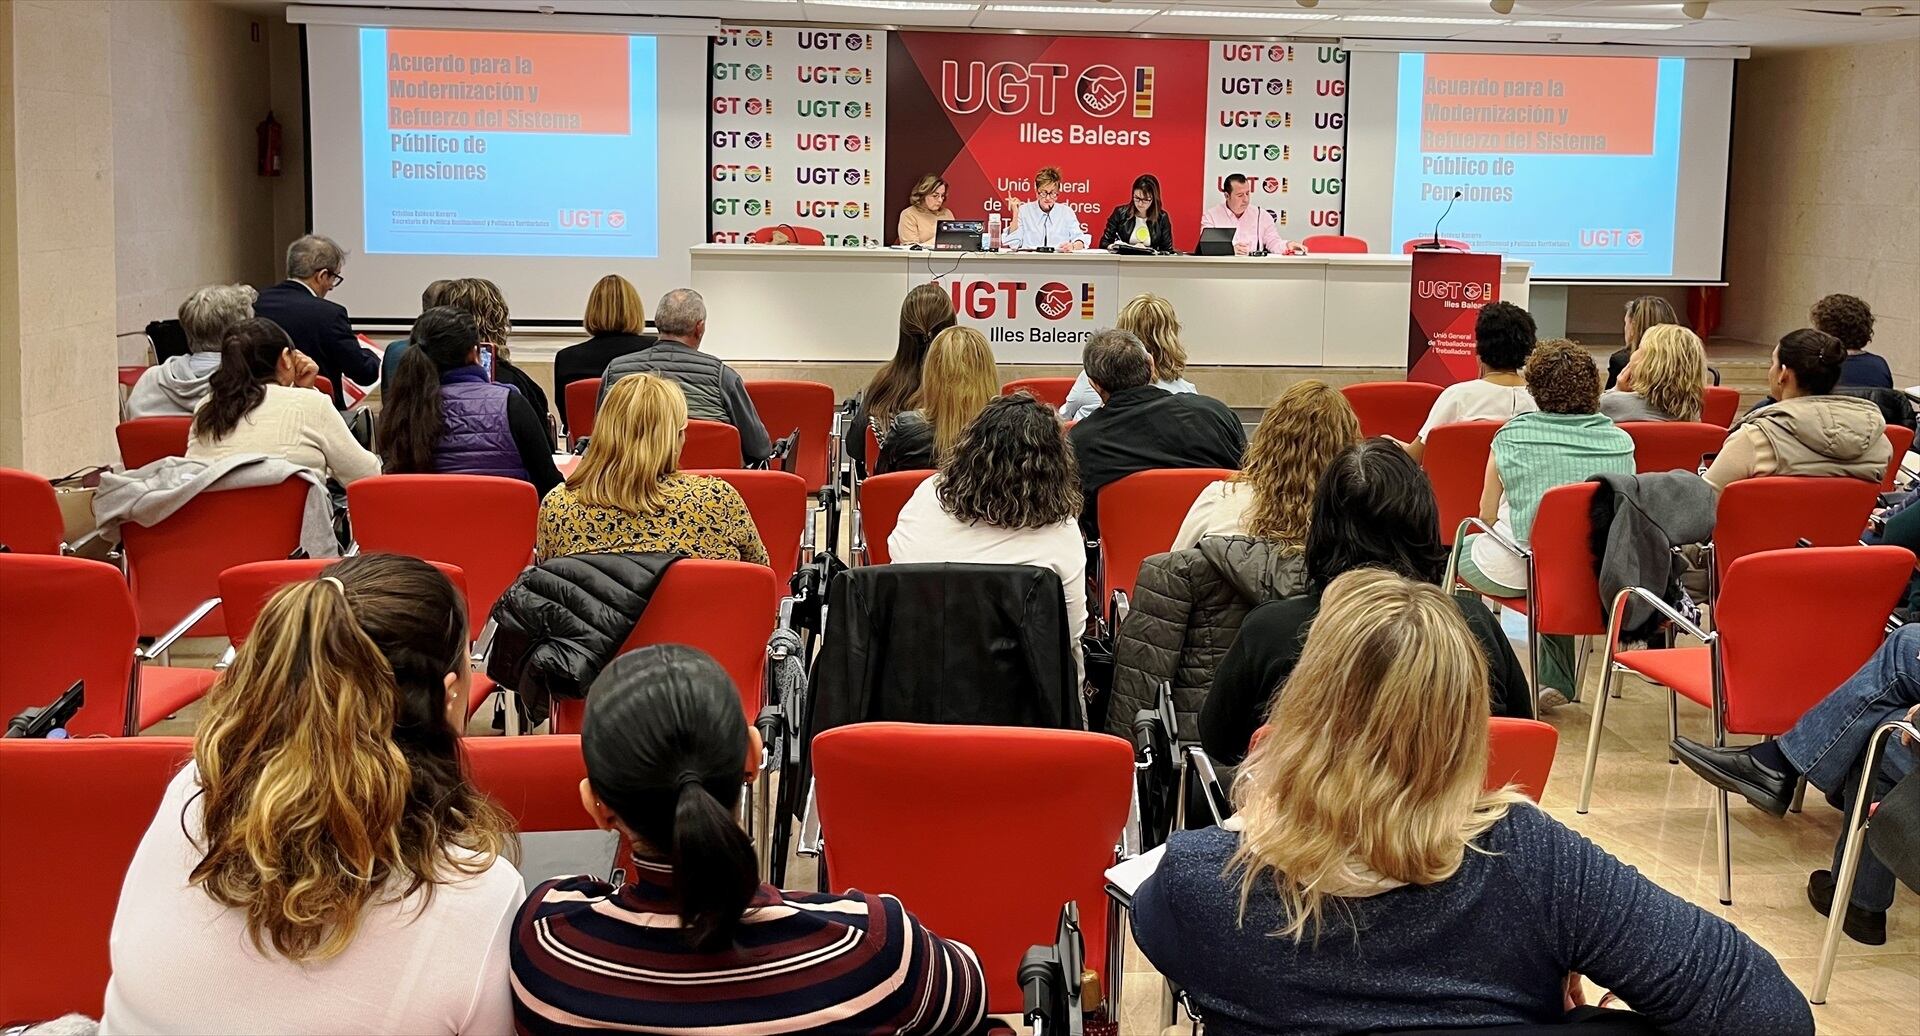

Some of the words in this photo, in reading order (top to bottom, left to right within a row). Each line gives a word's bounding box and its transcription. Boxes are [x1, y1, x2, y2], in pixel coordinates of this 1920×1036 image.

[714, 29, 741, 46] GT
[798, 32, 841, 50] UGT
[1223, 44, 1264, 61] UGT
[1317, 47, 1345, 64] UG
[388, 53, 465, 72] Acuerdo
[470, 56, 510, 75] para
[515, 55, 532, 74] la
[713, 63, 741, 80] GT
[798, 66, 841, 84] UGT
[389, 80, 524, 101] Modernización
[529, 85, 538, 102] y
[942, 60, 1068, 115] UGT
[1222, 77, 1263, 95] UGT
[1316, 79, 1345, 96] UG
[1425, 76, 1499, 96] Acuerdo
[1503, 79, 1543, 98] para
[1547, 78, 1564, 97] la
[713, 97, 741, 114] GT
[797, 100, 840, 117] UGT
[1424, 103, 1554, 123] Modernización
[1558, 107, 1569, 125] y
[389, 107, 470, 127] Refuerzo
[475, 109, 502, 128] del
[507, 109, 580, 129] Sistema
[1220, 111, 1262, 128] UGT
[1315, 113, 1345, 129] UG
[391, 133, 459, 153] Público
[464, 134, 486, 153] de
[713, 130, 741, 148] GT
[797, 134, 840, 151] UGT
[1020, 123, 1063, 144] Illes
[1069, 125, 1151, 146] Balears
[1423, 130, 1500, 149] Refuerzo
[1504, 131, 1532, 150] del
[1536, 131, 1606, 151] Sistema
[1219, 143, 1260, 160] UGT
[1313, 145, 1344, 162] UG
[391, 160, 487, 180] Pensiones
[713, 164, 740, 181] GT
[1422, 155, 1489, 175] Público
[1493, 156, 1514, 175] de
[797, 167, 839, 185] UGT
[998, 178, 1030, 191] Unió
[1218, 176, 1259, 193] UT
[1312, 178, 1343, 194] UG
[1421, 183, 1513, 202] Pensiones
[713, 198, 740, 215] GT
[796, 201, 839, 218] UGT
[984, 198, 1001, 211] de
[559, 210, 603, 228] UGT
[1310, 210, 1342, 227] UG
[713, 232, 740, 243] GT
[1580, 230, 1622, 247] UGT
[1418, 280, 1462, 299] UGT
[990, 327, 1024, 342] Illes
[1030, 328, 1092, 343] Balears
